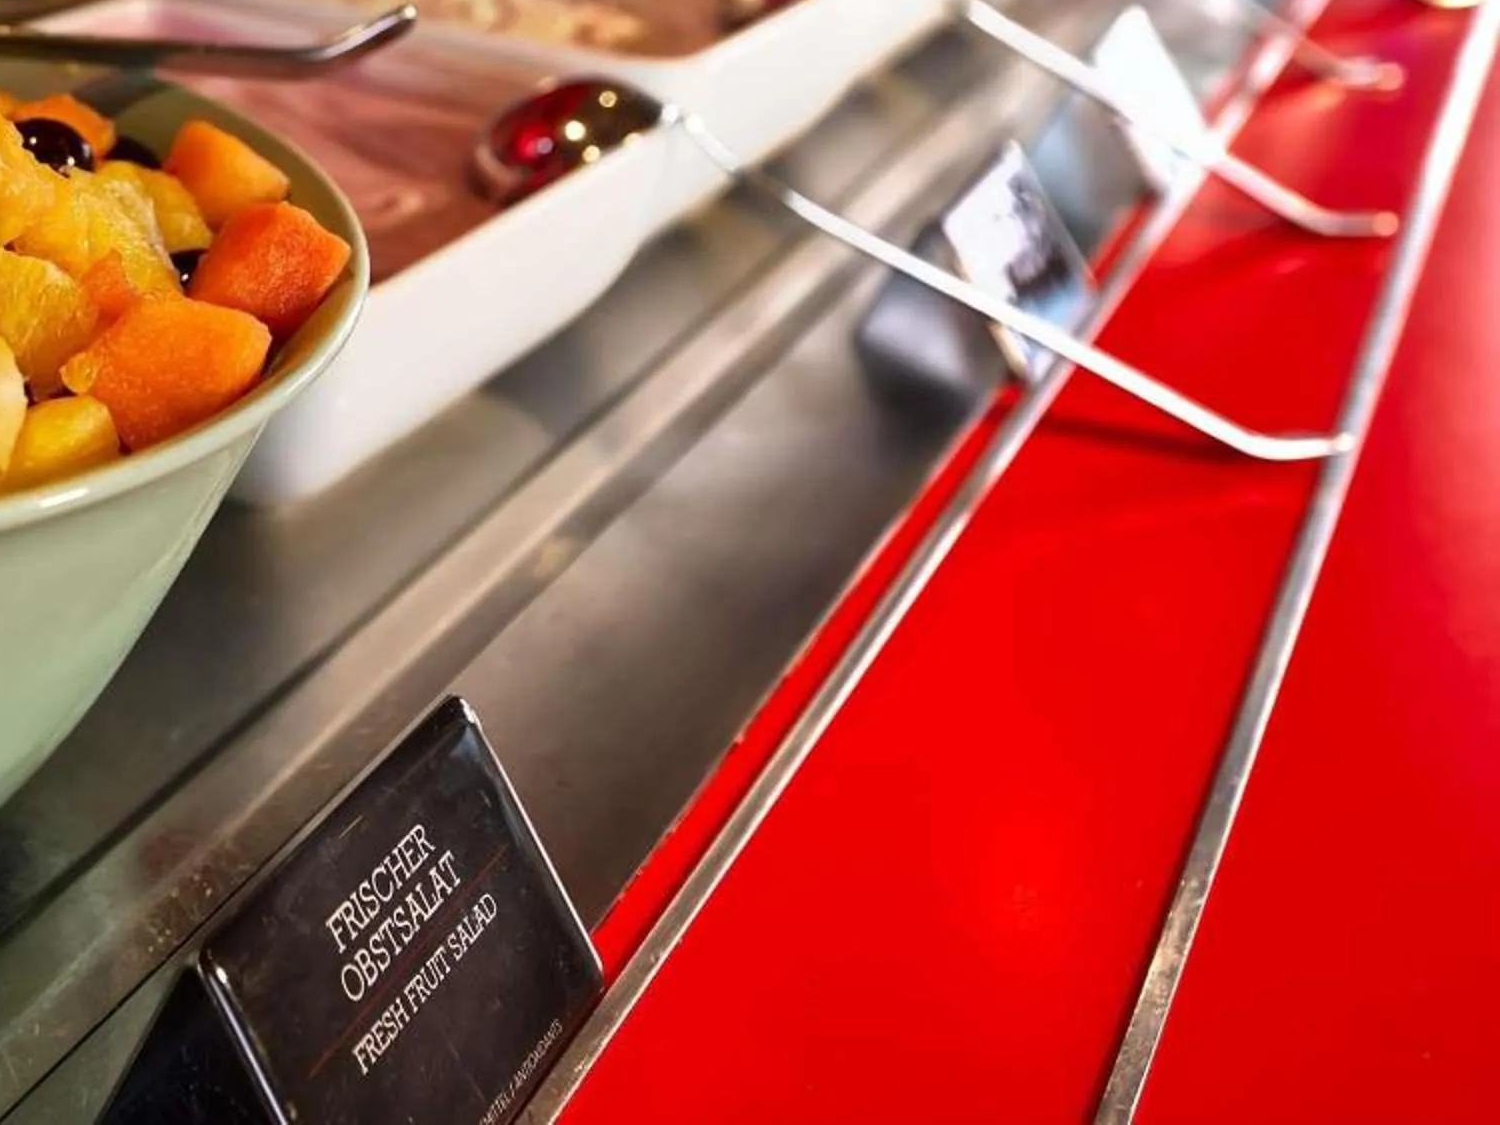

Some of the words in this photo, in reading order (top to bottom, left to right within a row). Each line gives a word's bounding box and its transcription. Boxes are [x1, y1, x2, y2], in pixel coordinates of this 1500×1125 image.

[325, 824, 436, 954] FRISCHER
[341, 850, 461, 1002] OBSTSALAT
[352, 997, 411, 1075] FRESH
[404, 946, 451, 1012] FRUIT
[447, 893, 498, 961] SALAD
